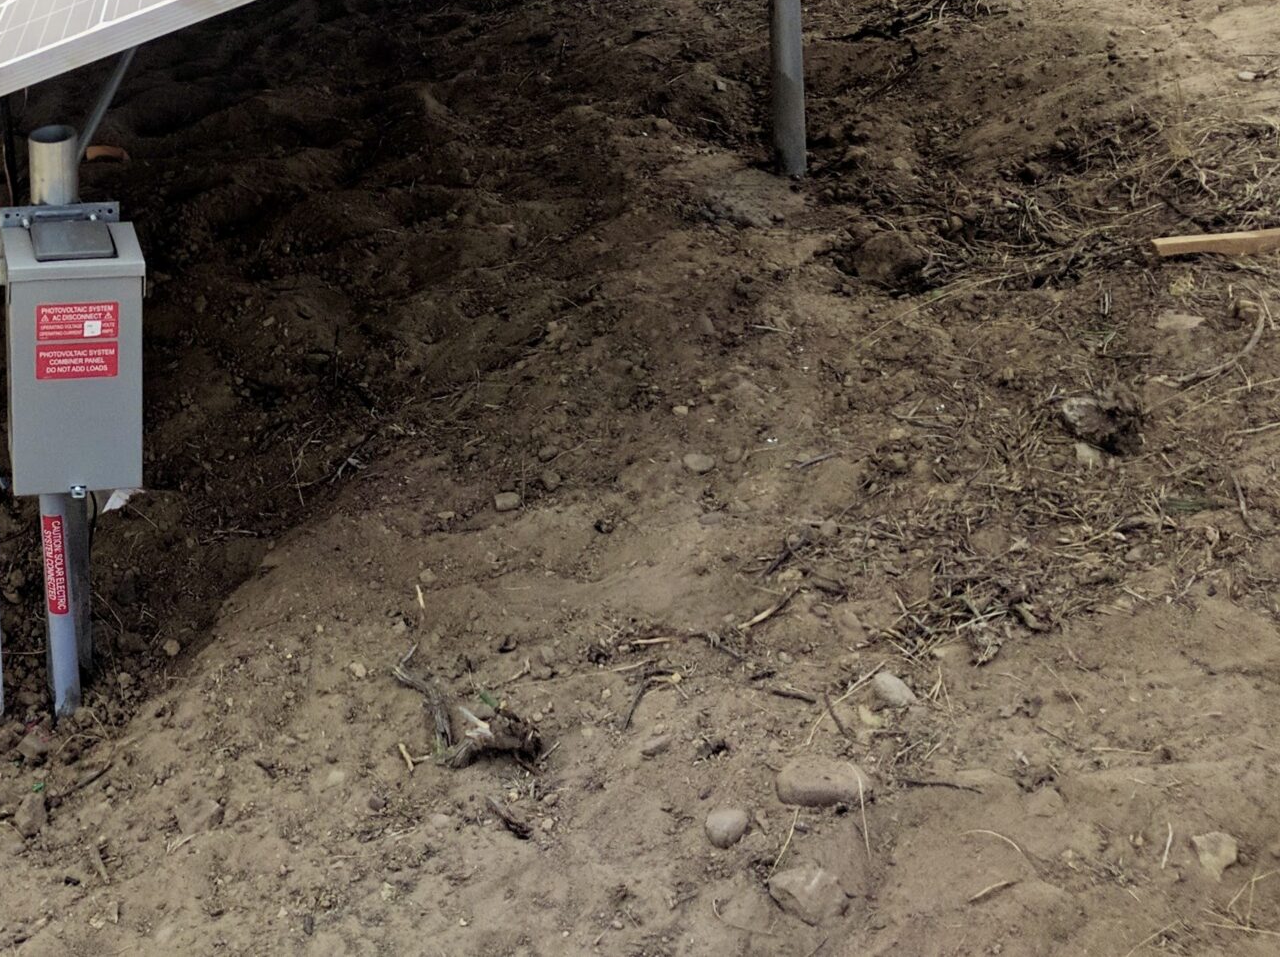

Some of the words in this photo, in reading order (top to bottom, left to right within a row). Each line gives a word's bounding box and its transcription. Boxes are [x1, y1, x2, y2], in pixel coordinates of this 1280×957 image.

[41, 306, 87, 314] PHOTOVOLTAIC
[62, 313, 102, 321] DISCONNECT
[40, 350, 87, 358] PHOTOVOLTAIC
[89, 348, 115, 356] SYSTEM
[44, 530, 53, 558] SYSTEM
[54, 554, 64, 576] SOLAR
[47, 558, 56, 600] CONNECTED
[56, 577, 66, 610] ELECTRIC
